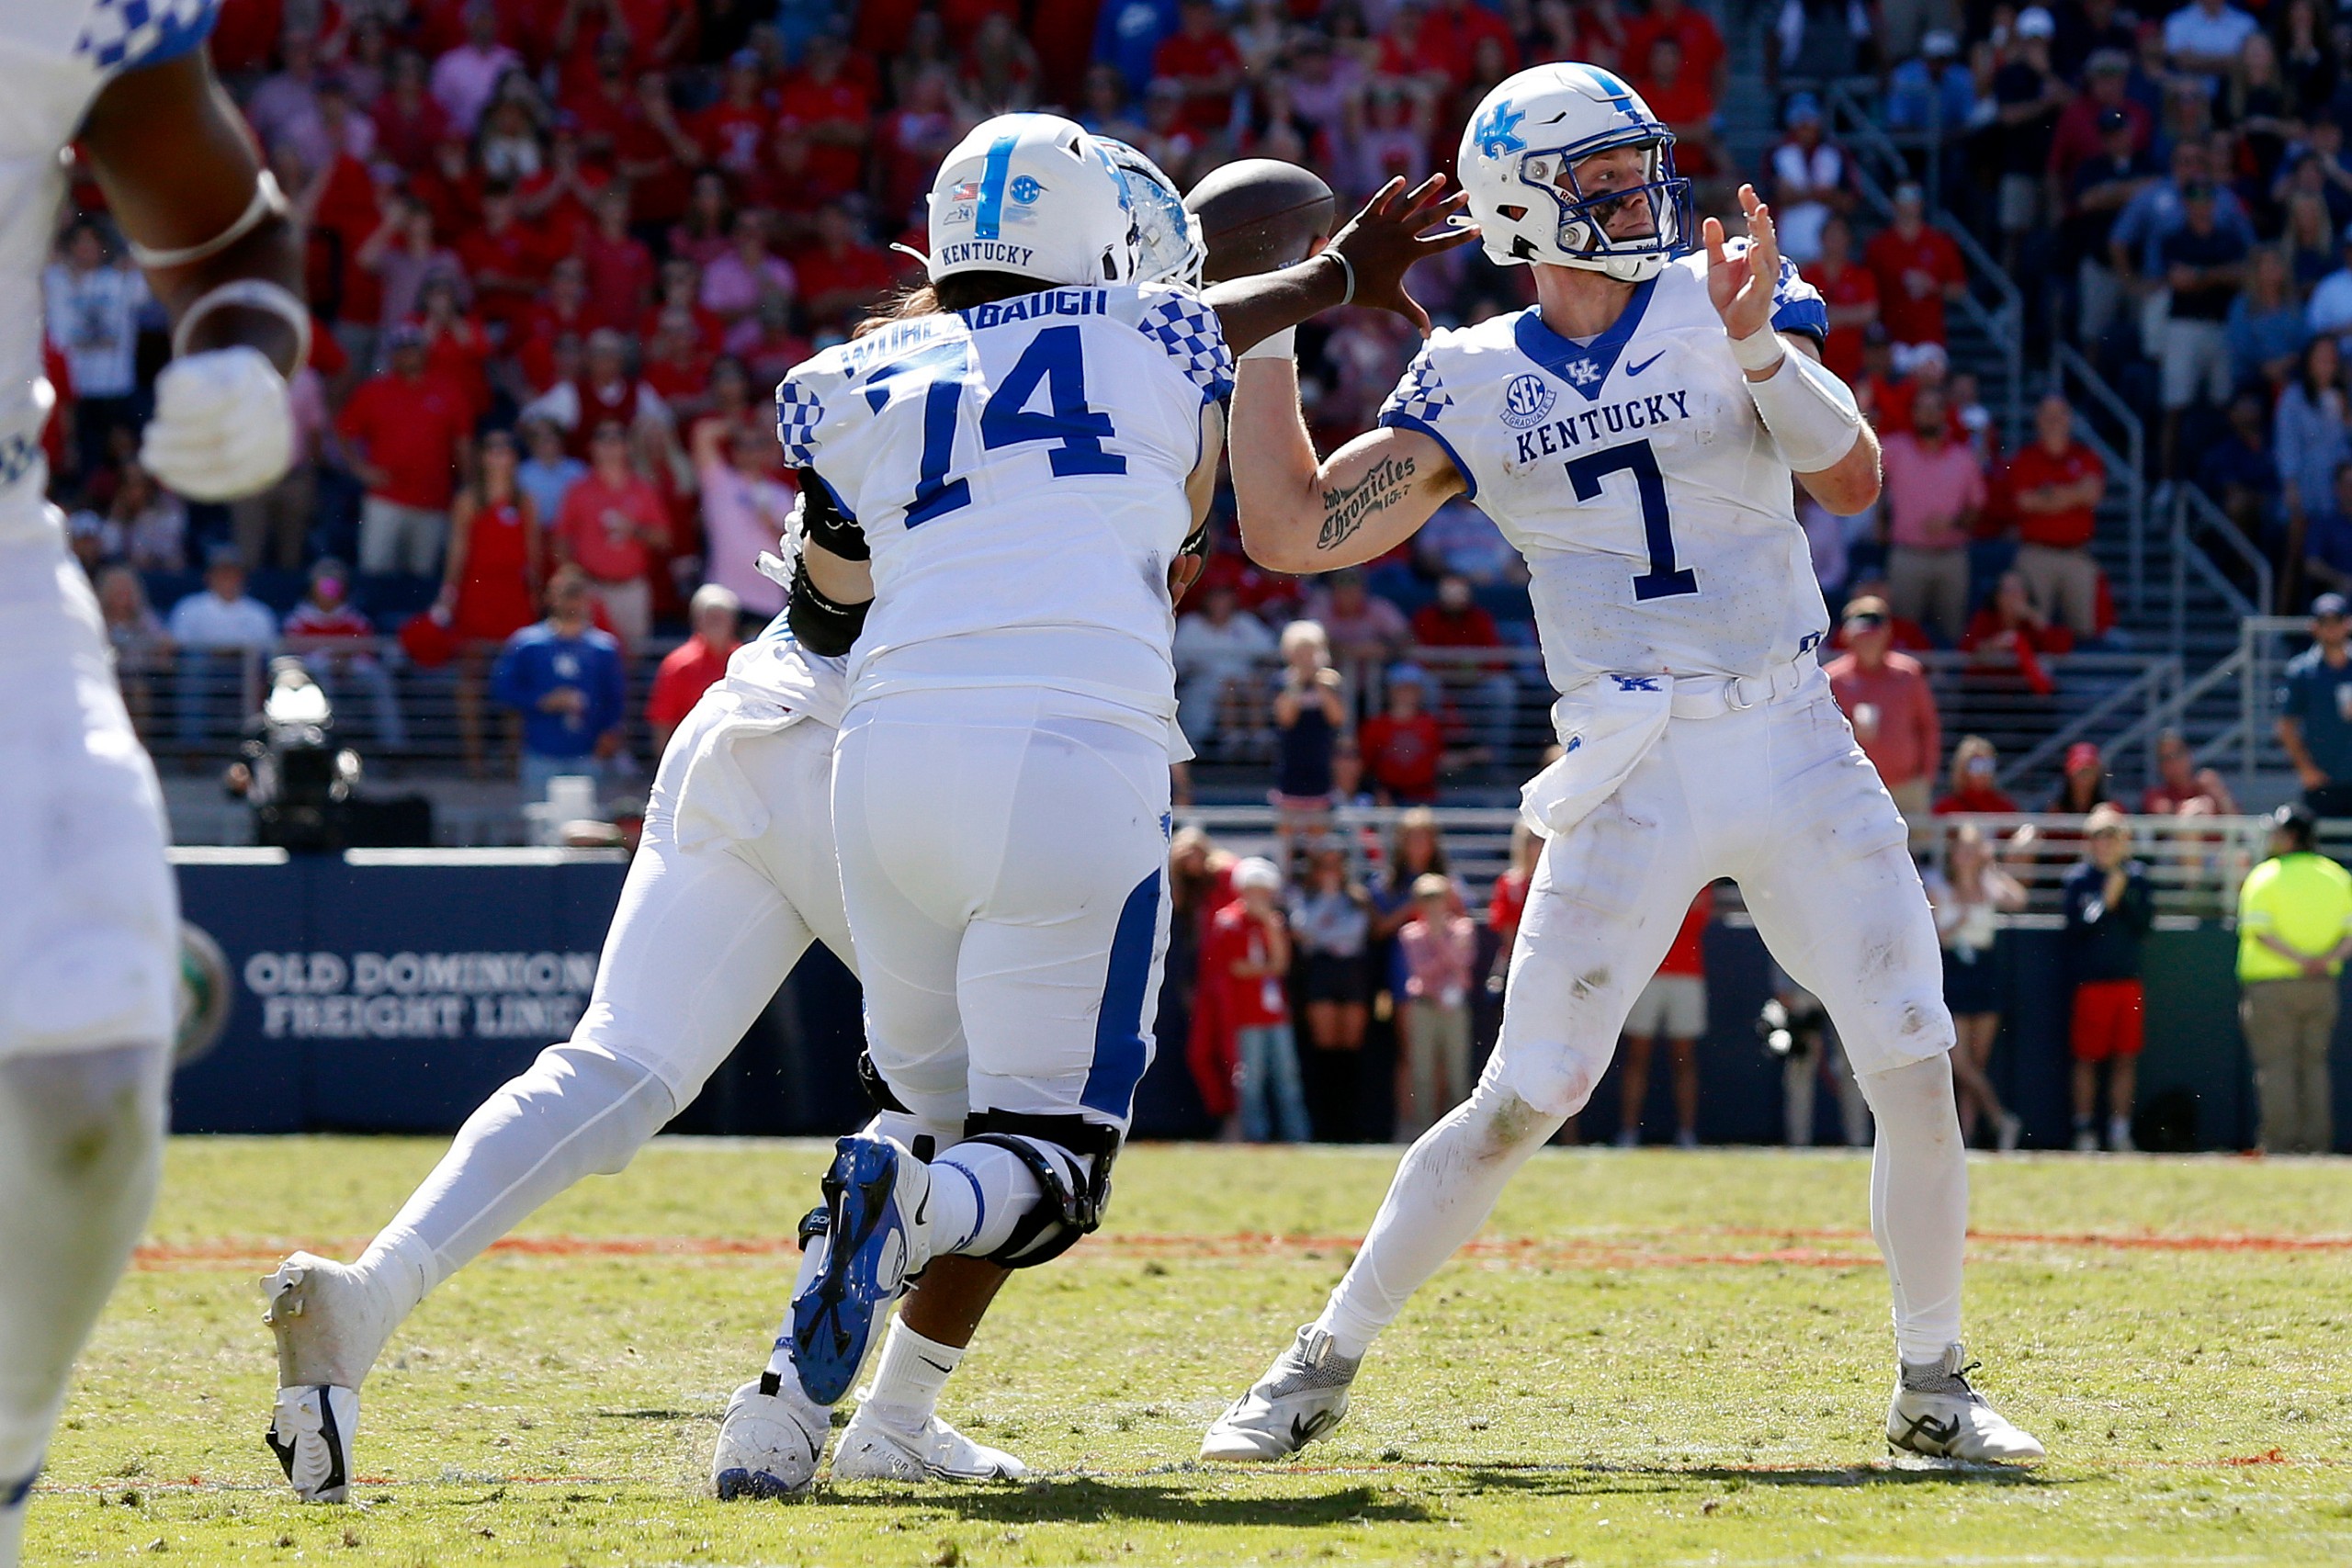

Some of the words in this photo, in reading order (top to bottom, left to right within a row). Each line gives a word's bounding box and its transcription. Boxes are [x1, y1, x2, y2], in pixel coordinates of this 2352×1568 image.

[1011, 175, 1039, 204] SEC
[942, 243, 1034, 266] KENTUCKY
[1566, 357, 1602, 386] UK
[1508, 376, 1544, 414] SEC
[1509, 397, 1554, 427] GRADUATE
[865, 325, 1126, 529] 74
[1516, 390, 1690, 464] KENTUCKY
[1317, 457, 1416, 548] Chronicles
[1565, 438, 1699, 602] 7
[245, 953, 345, 993] OLD
[355, 953, 597, 992] DOMINION
[264, 998, 463, 1037] FREIGHT
